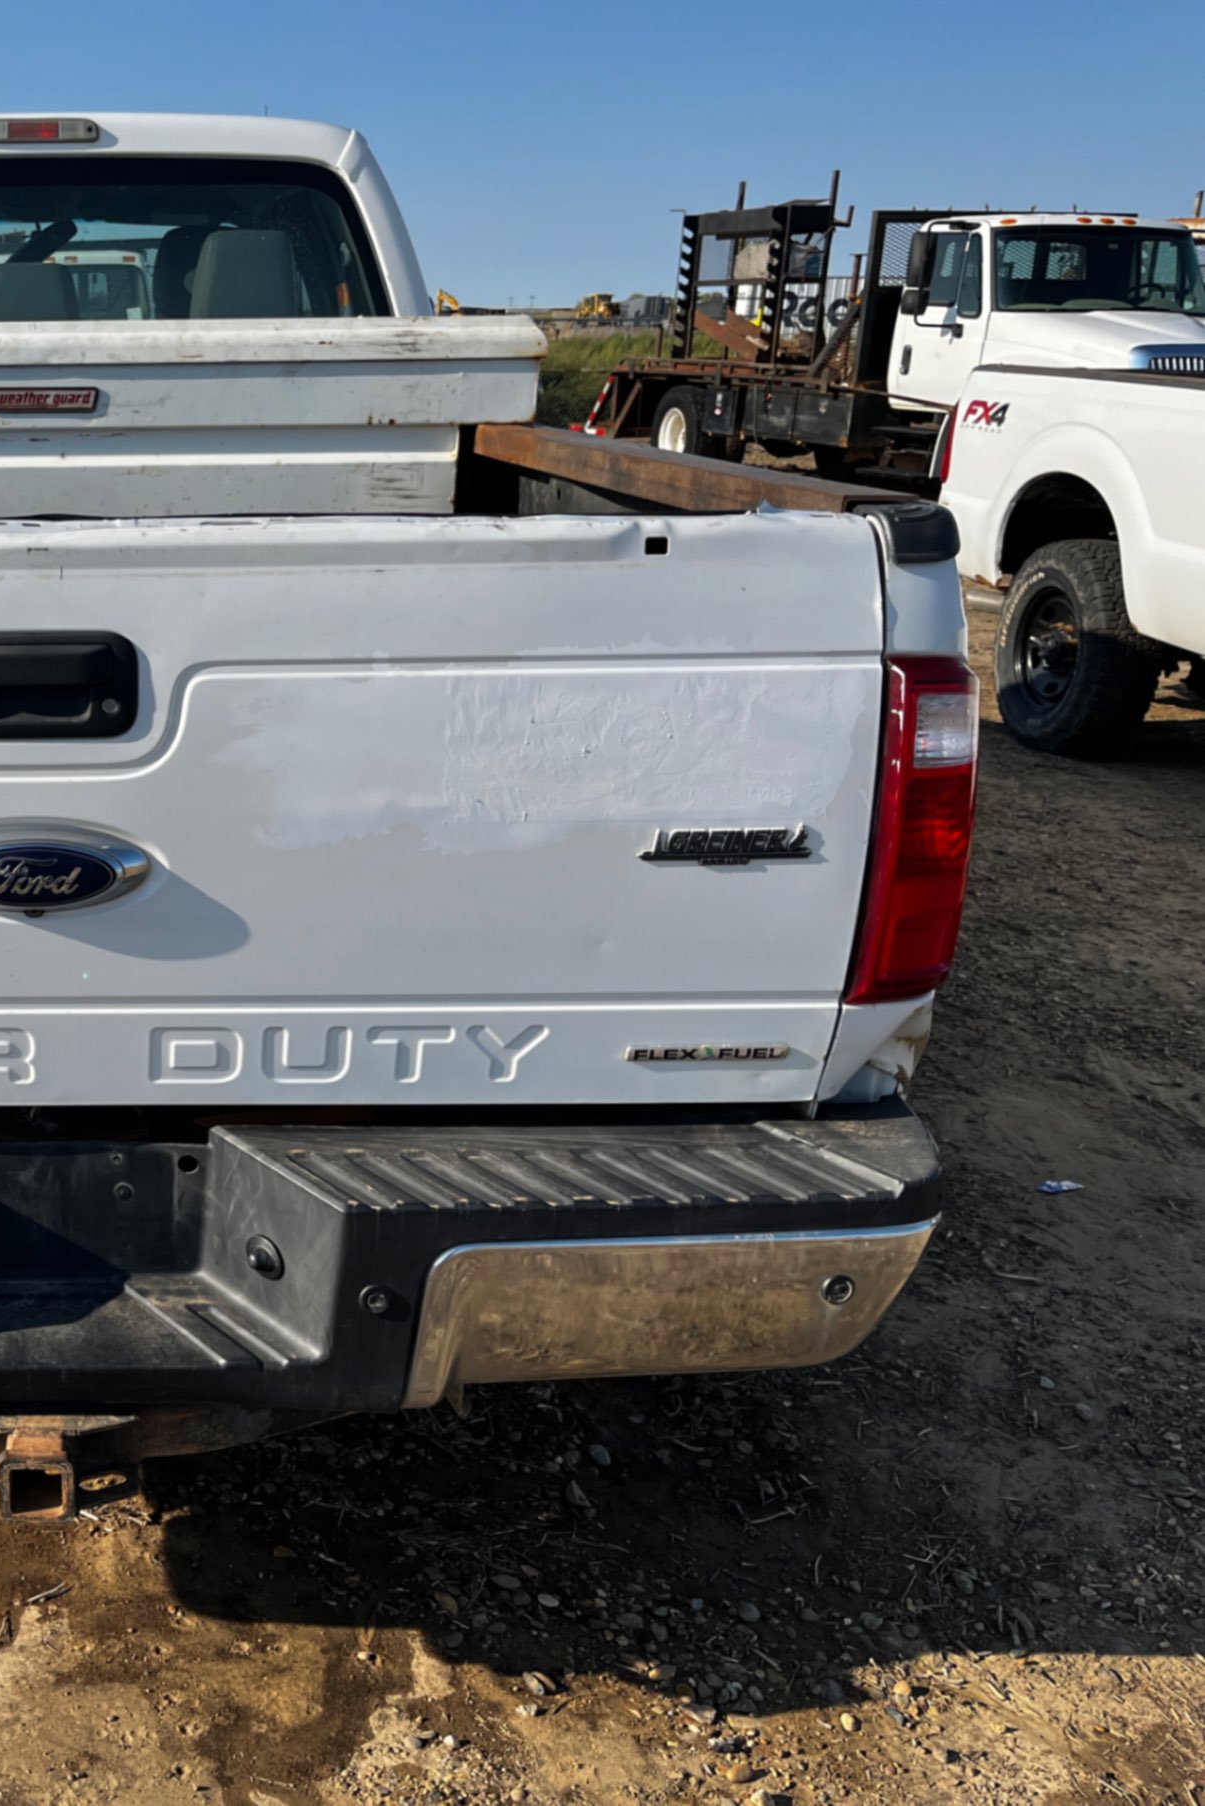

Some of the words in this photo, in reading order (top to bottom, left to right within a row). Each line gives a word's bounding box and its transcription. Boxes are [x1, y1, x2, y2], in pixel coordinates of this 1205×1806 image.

[53, 389, 92, 405] guard
[962, 399, 1011, 427] FX4
[667, 828, 787, 853] GREINER
[147, 1024, 551, 1085] DUTY
[633, 1048, 698, 1061] FLEX
[718, 1047, 783, 1060] FUEL
